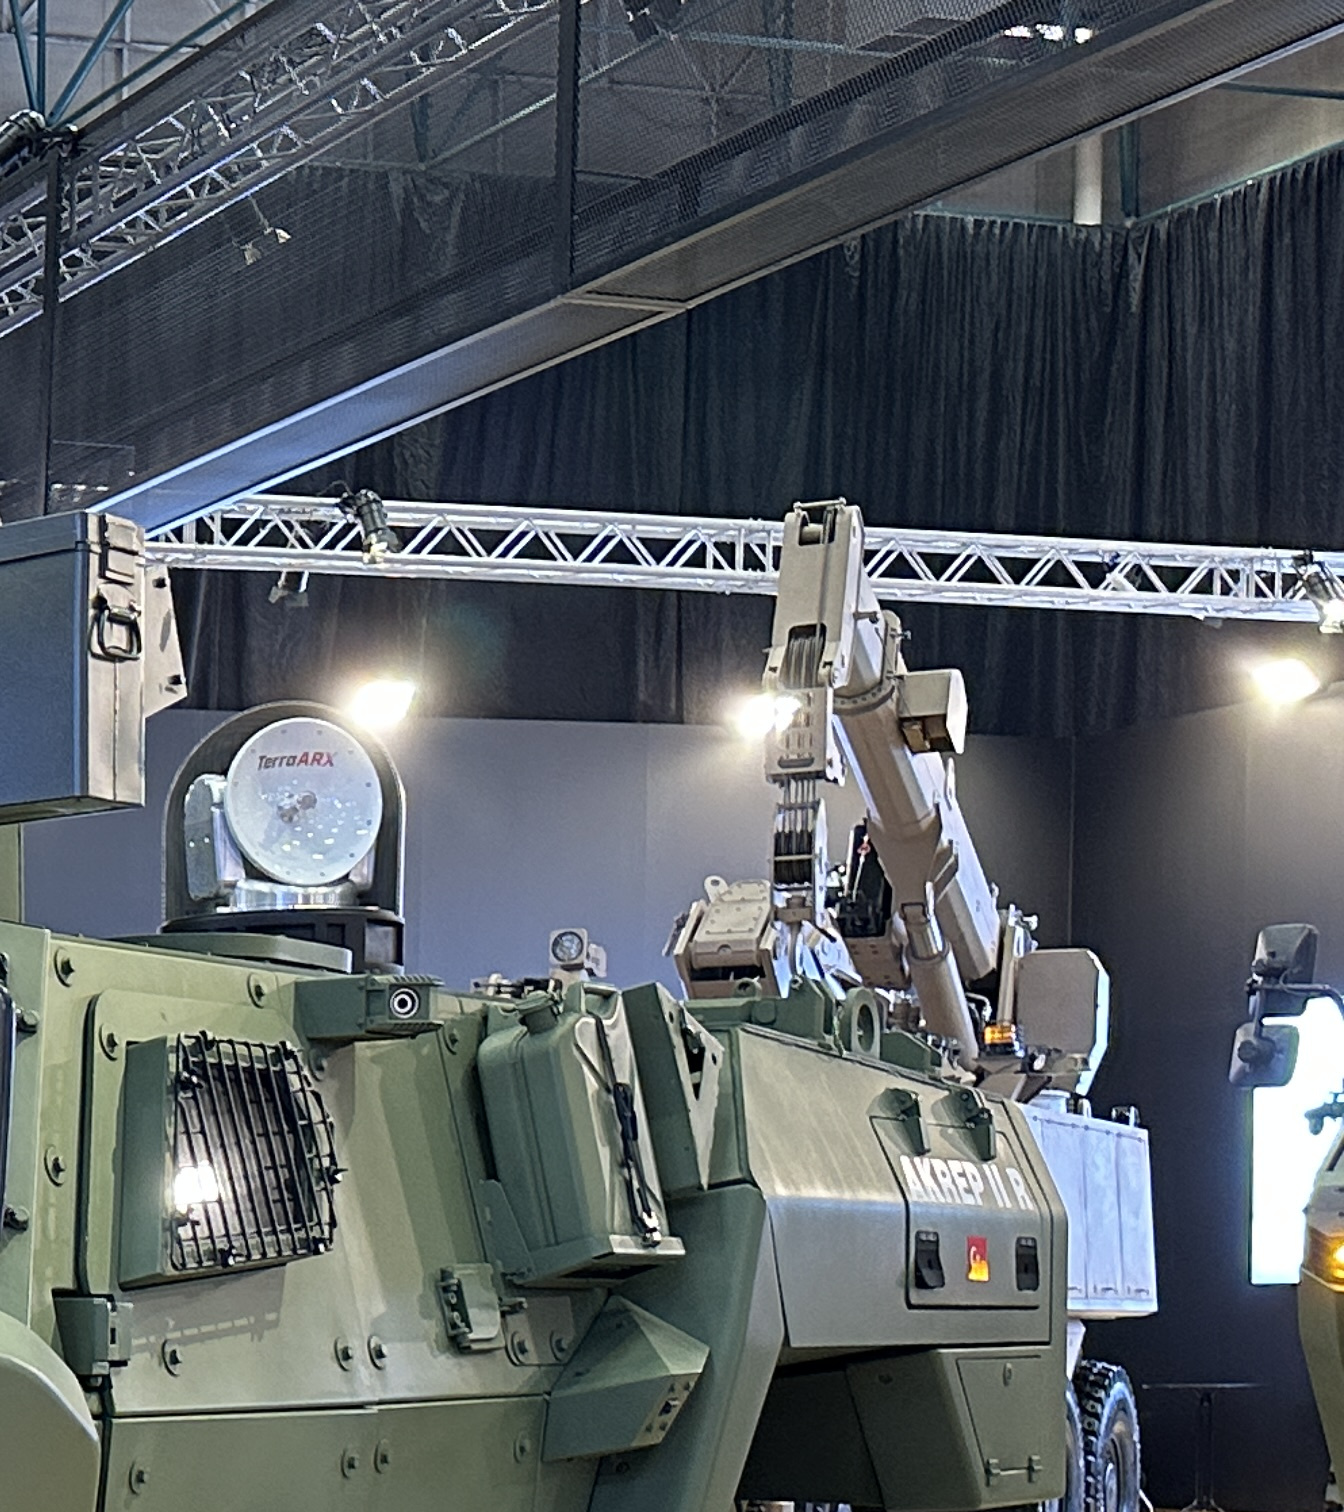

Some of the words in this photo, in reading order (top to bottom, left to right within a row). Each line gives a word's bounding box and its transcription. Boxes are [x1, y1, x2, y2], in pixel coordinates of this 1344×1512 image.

[257, 751, 339, 771] TerraARX
[899, 1155, 985, 1207] AKREP
[982, 1163, 1012, 1209] II
[1006, 1167, 1035, 1211] R
